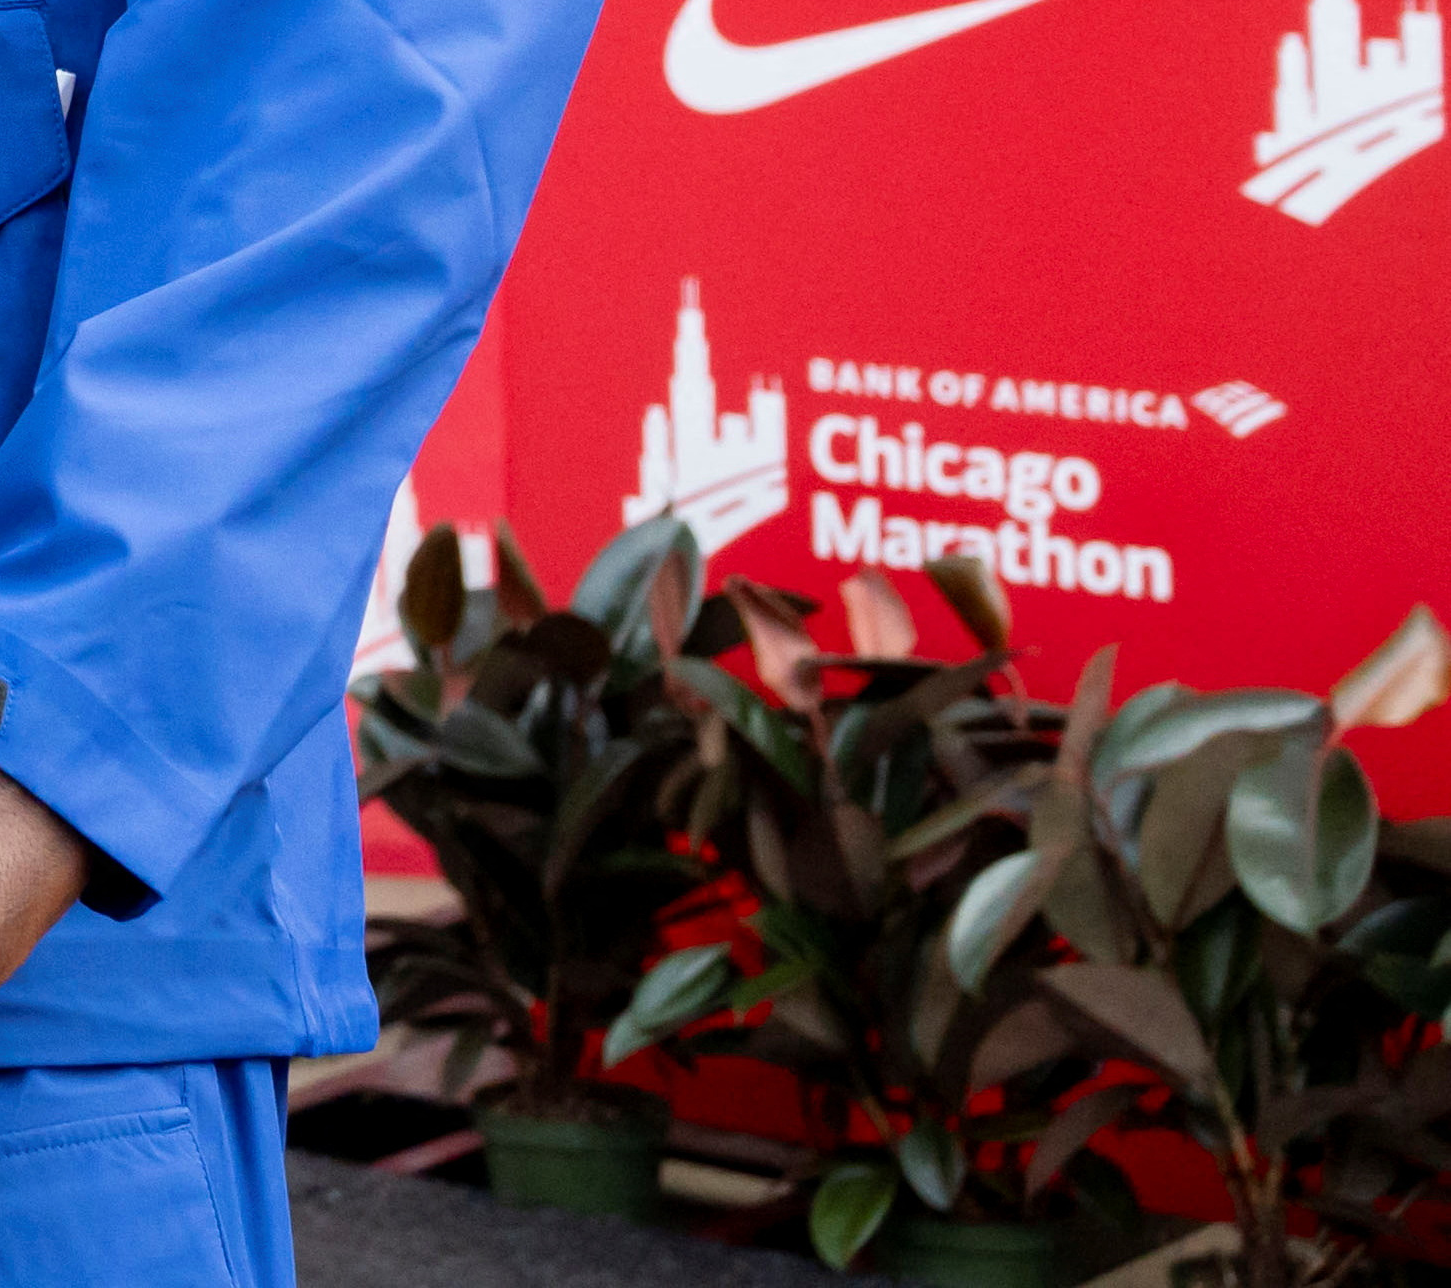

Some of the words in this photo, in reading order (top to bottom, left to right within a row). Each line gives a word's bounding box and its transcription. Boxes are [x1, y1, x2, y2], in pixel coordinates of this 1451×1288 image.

[808, 356, 922, 403] BANK
[928, 369, 985, 409] OF
[990, 375, 1190, 431] AMERICA
[808, 412, 1102, 523] Chicago
[810, 489, 1175, 603] Marathon
